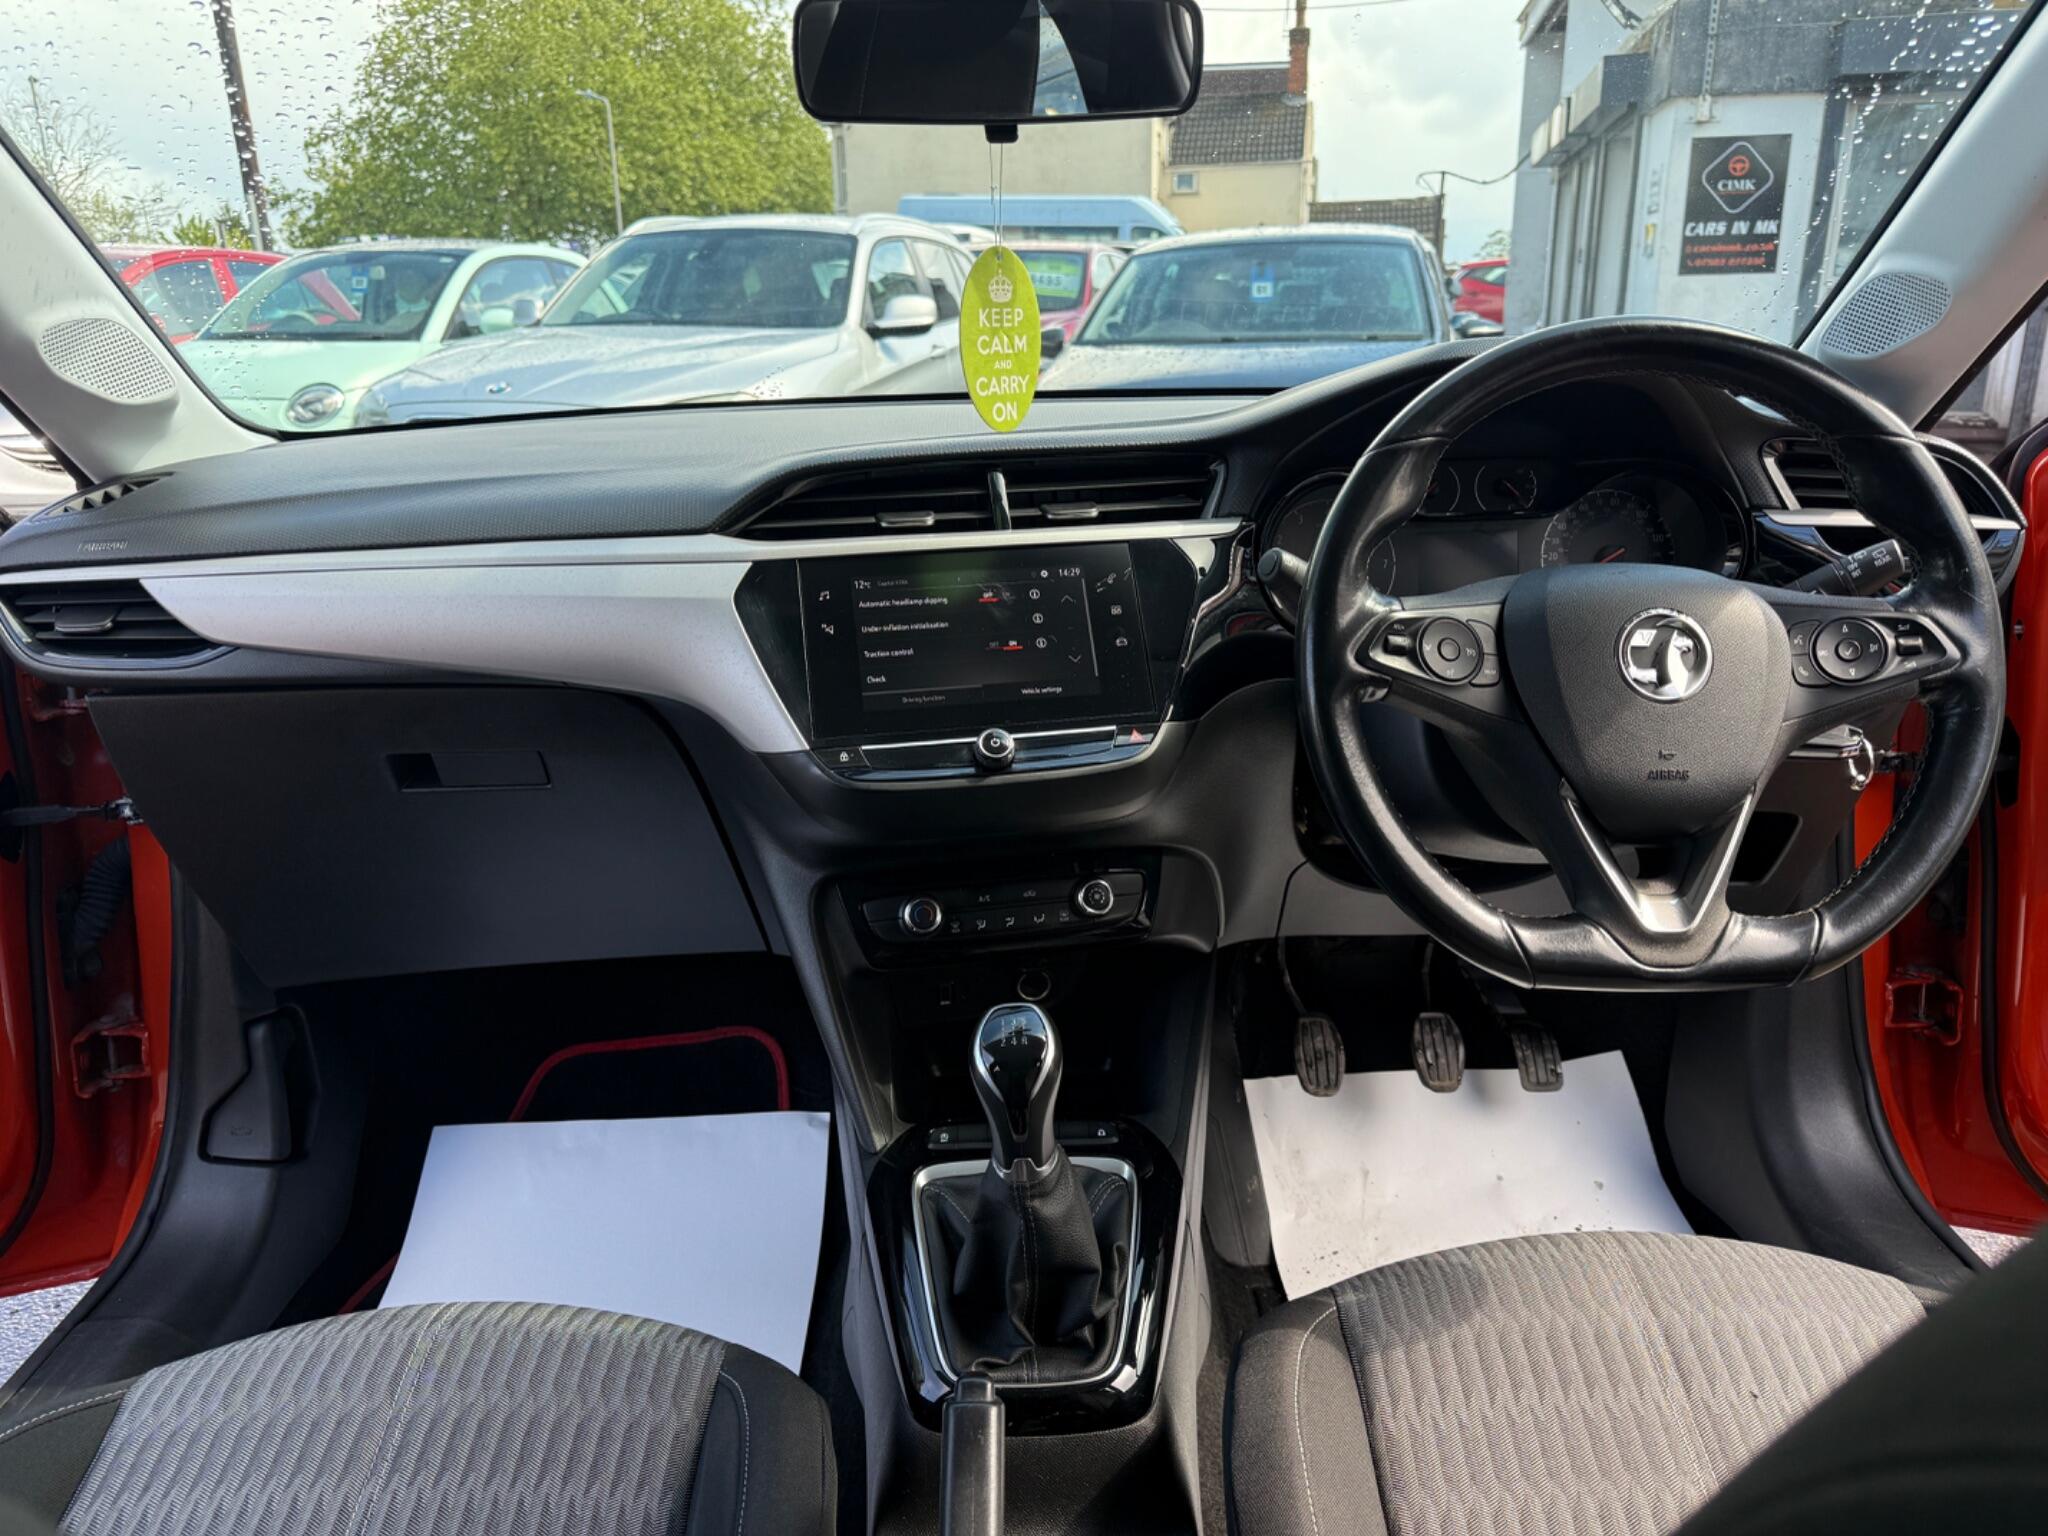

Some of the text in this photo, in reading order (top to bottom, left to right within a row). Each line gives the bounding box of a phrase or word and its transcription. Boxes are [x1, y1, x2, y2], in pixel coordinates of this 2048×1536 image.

[1684, 219, 1779, 237] CARS IN MK
[978, 307, 1024, 328] KEEP
[976, 334, 1028, 356] CALM
[993, 359, 1013, 369] AND
[975, 374, 1031, 397] CARRY
[991, 402, 1018, 423] ON
[1058, 567, 1081, 577] 14:29
[858, 596, 949, 609] Automatic headlamp dipping
[861, 624, 881, 633] Under
[863, 647, 914, 658] Traction control
[866, 675, 886, 684] Check
[1021, 686, 1062, 696] Vehicle settings
[1647, 769, 1690, 781] AIRBAG
